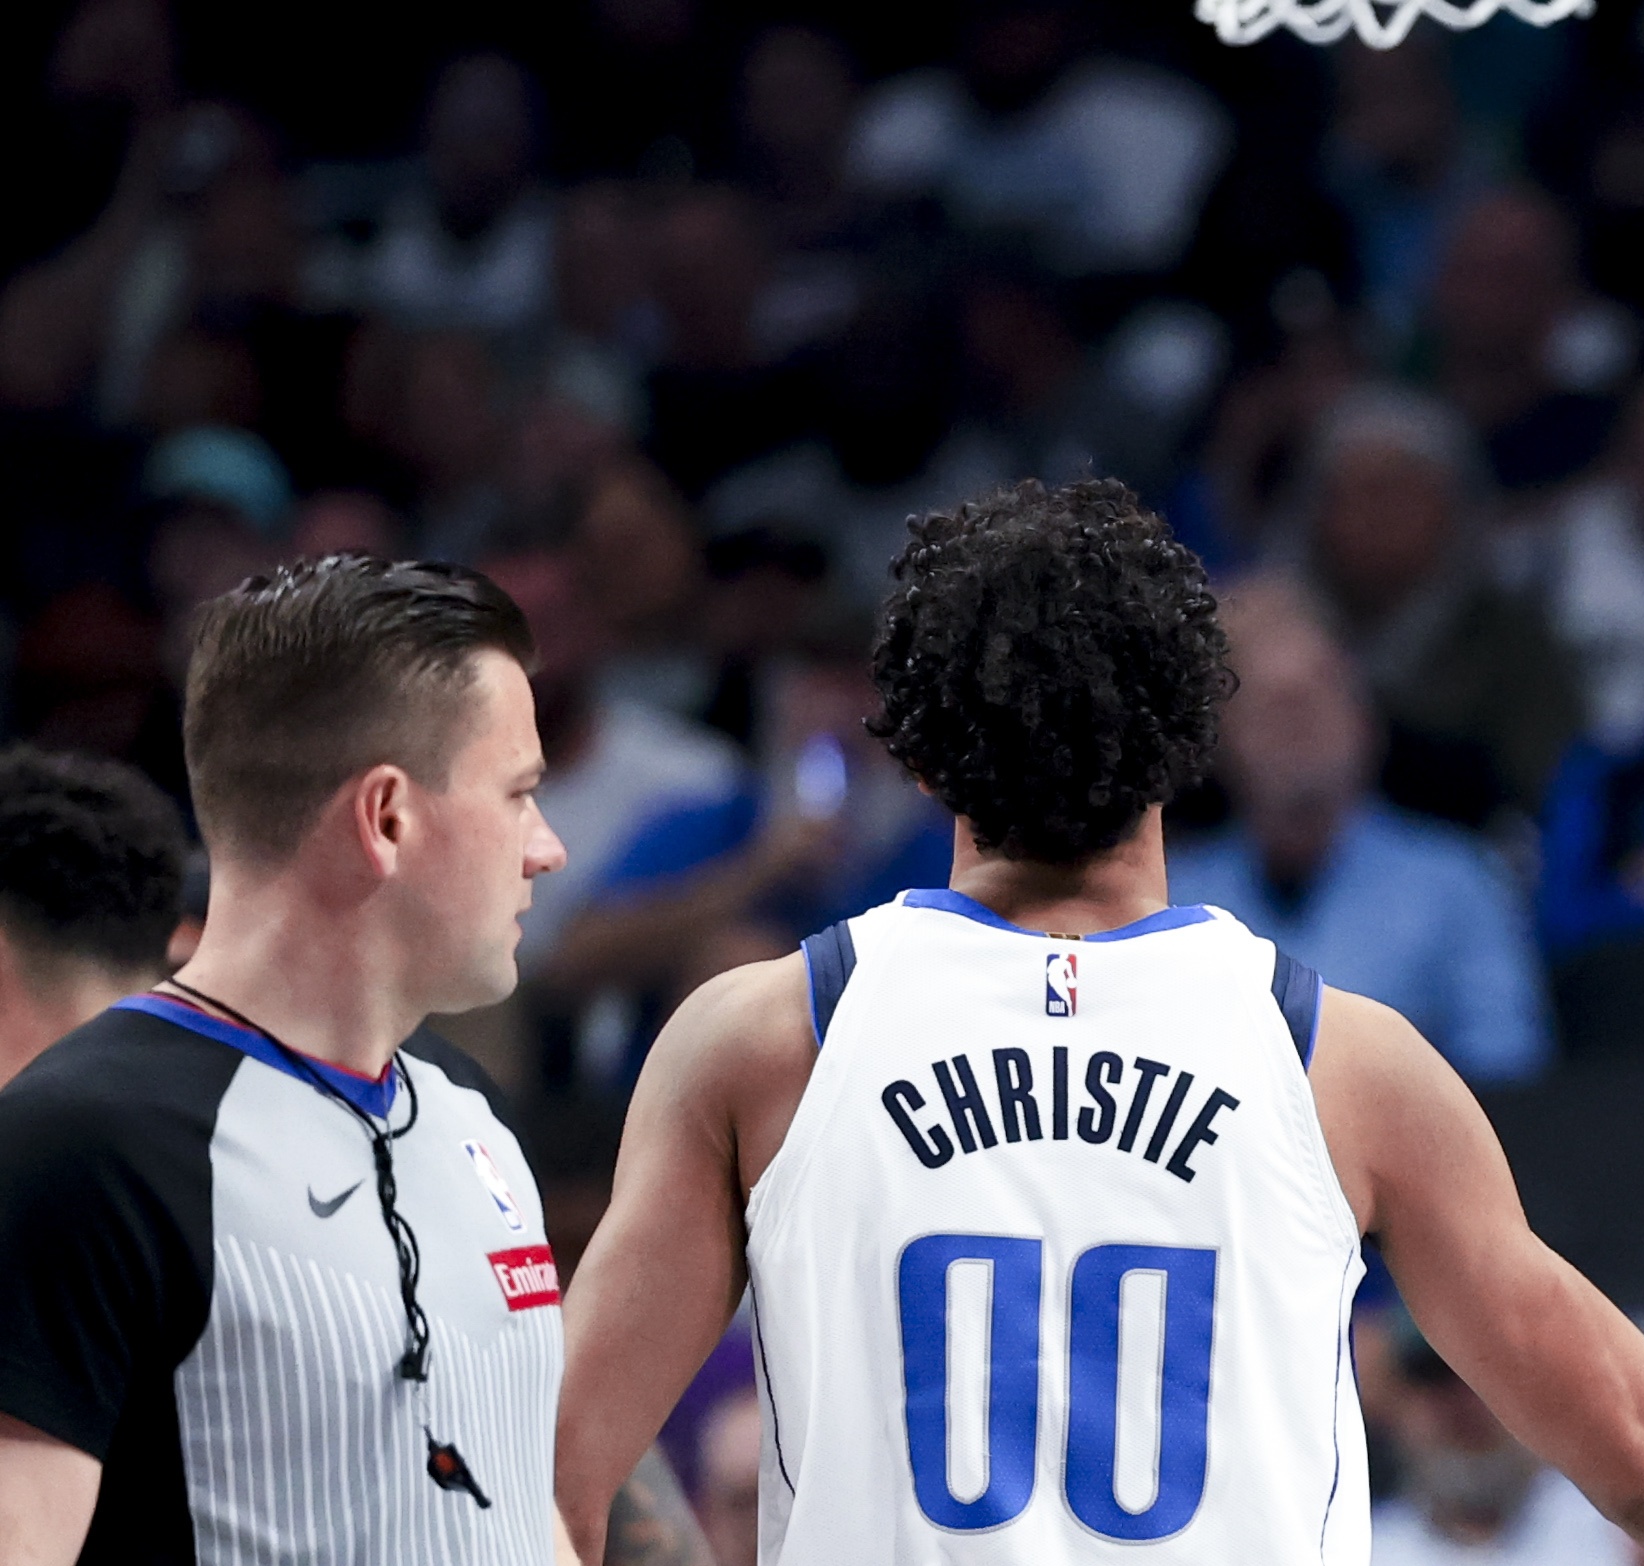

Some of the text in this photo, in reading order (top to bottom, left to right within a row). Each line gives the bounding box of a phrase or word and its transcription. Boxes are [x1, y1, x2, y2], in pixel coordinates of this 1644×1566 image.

[1048, 1000, 1066, 1014] NBA
[881, 1047, 1240, 1183] CHRISTIE
[896, 1231, 1220, 1545] 00
